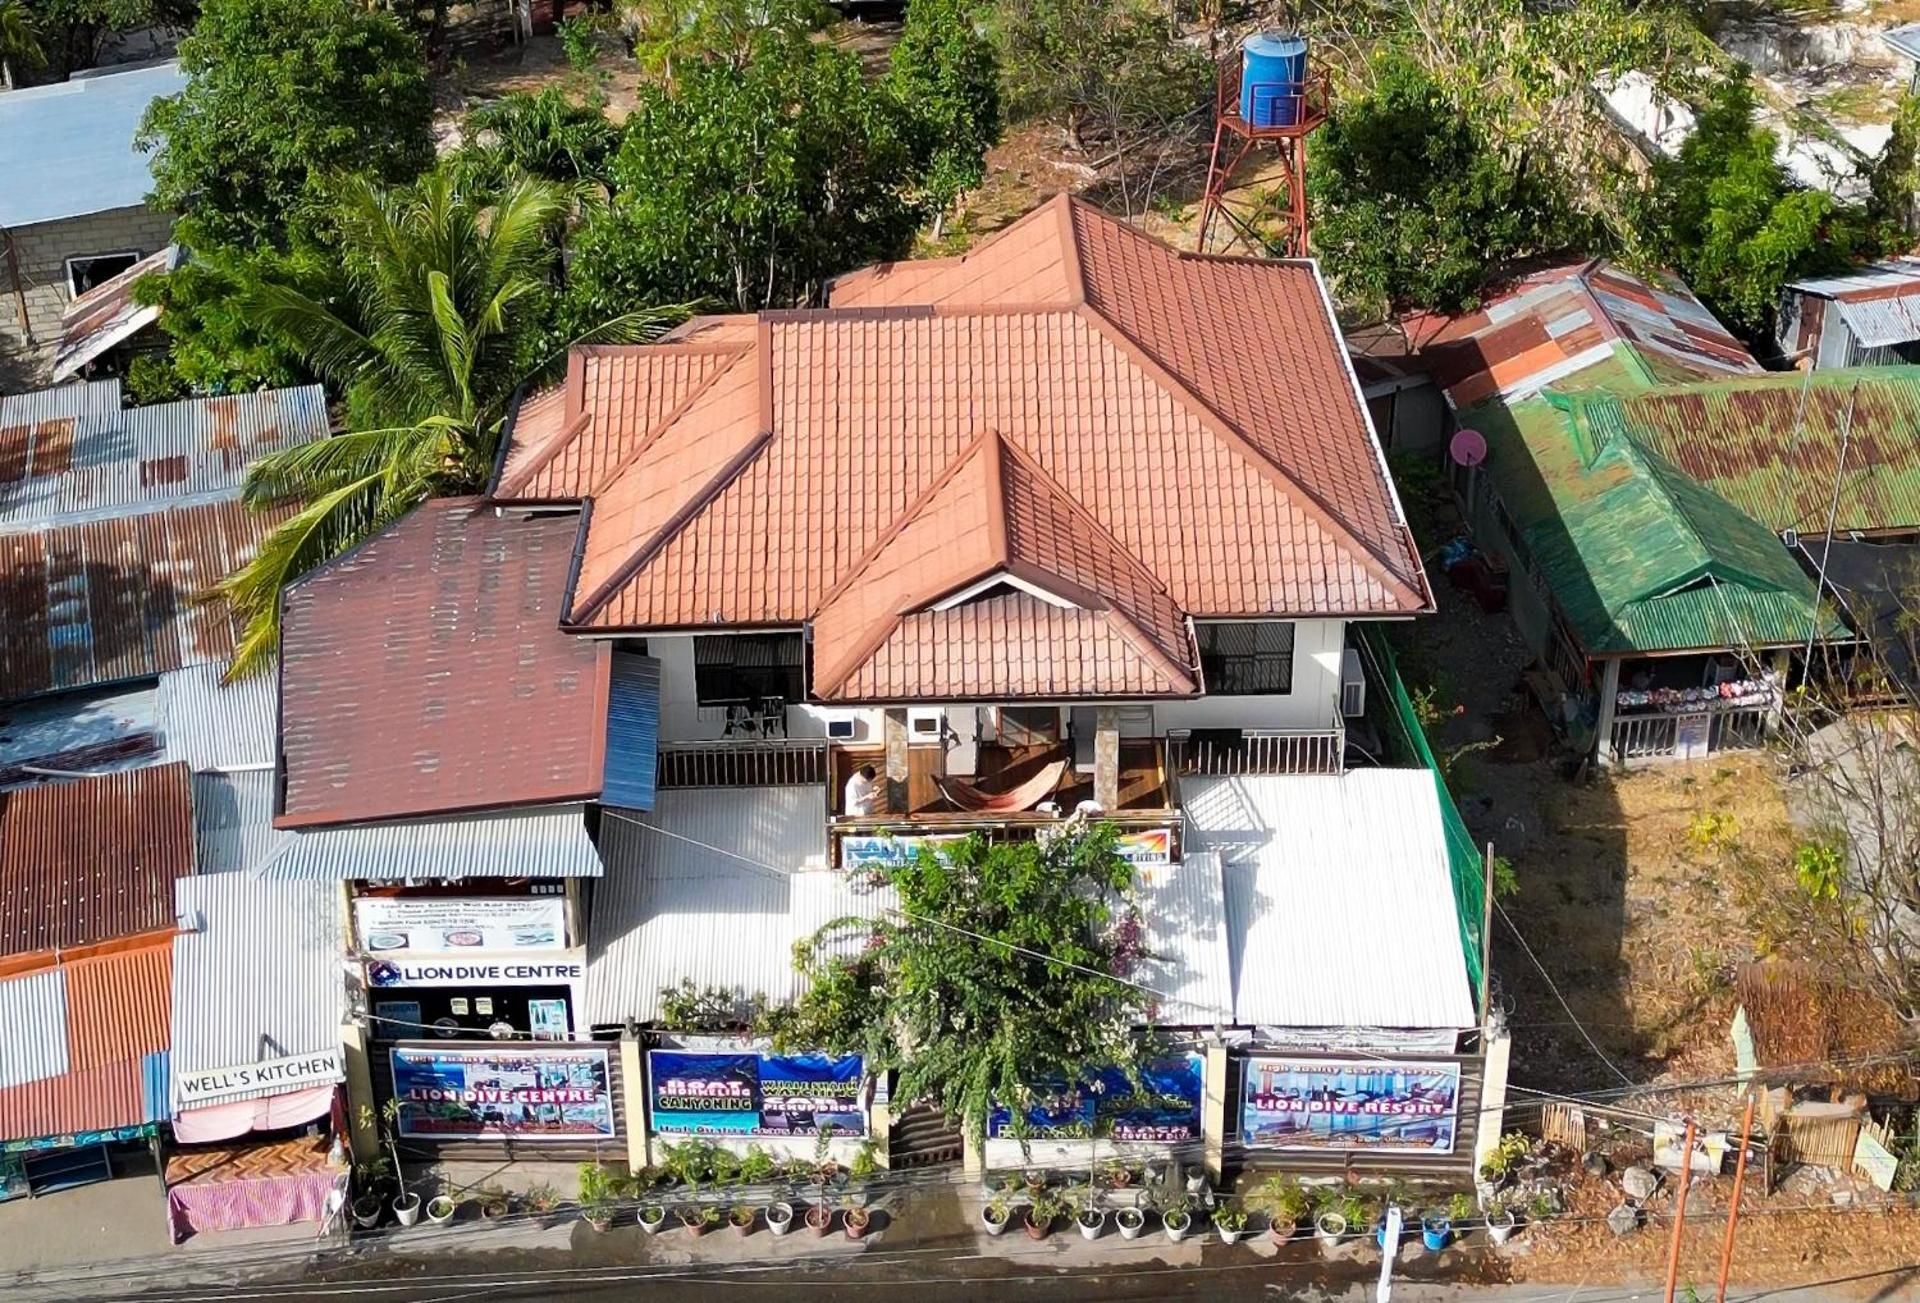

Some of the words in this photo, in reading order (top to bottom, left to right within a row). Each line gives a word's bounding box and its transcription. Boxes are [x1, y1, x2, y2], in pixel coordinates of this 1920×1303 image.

[404, 966, 453, 981] LION
[457, 966, 500, 980] DIVE
[503, 964, 581, 979] CENTRE
[183, 1069, 251, 1094] WELL'S
[256, 1055, 335, 1082] KITCHEN
[1259, 1063, 1289, 1073] High
[1293, 1064, 1341, 1075] Quality
[410, 1088, 457, 1101] LION
[463, 1089, 510, 1103] DIVE
[516, 1089, 595, 1103] CENTRE
[659, 1096, 752, 1111] CANYONING
[1256, 1099, 1304, 1112] LION
[1310, 1100, 1359, 1114] DIVE
[1365, 1101, 1445, 1115] RESORT
